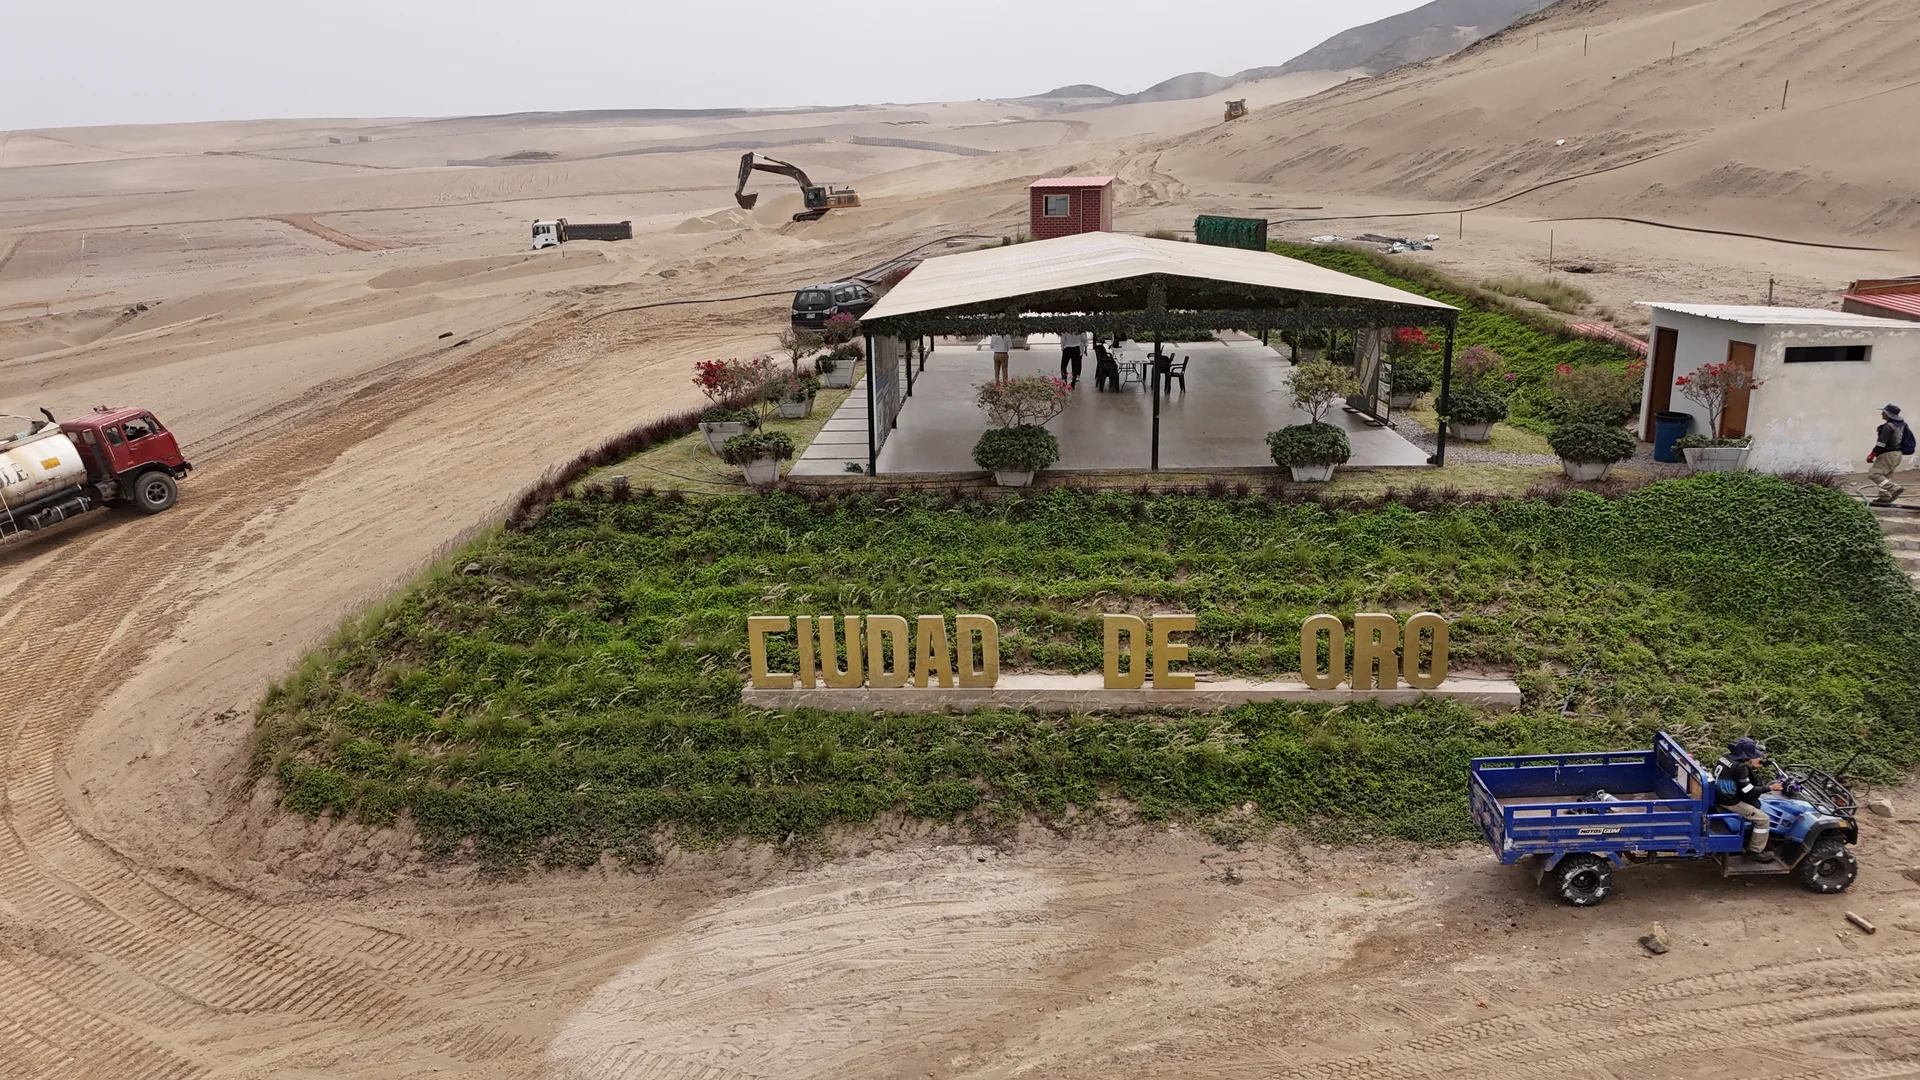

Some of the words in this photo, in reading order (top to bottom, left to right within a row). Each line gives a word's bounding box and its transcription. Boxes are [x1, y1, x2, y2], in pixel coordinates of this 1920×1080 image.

[747, 614, 1000, 689] CIUDAD
[1103, 613, 1196, 690] DE
[1300, 612, 1449, 690] ORO
